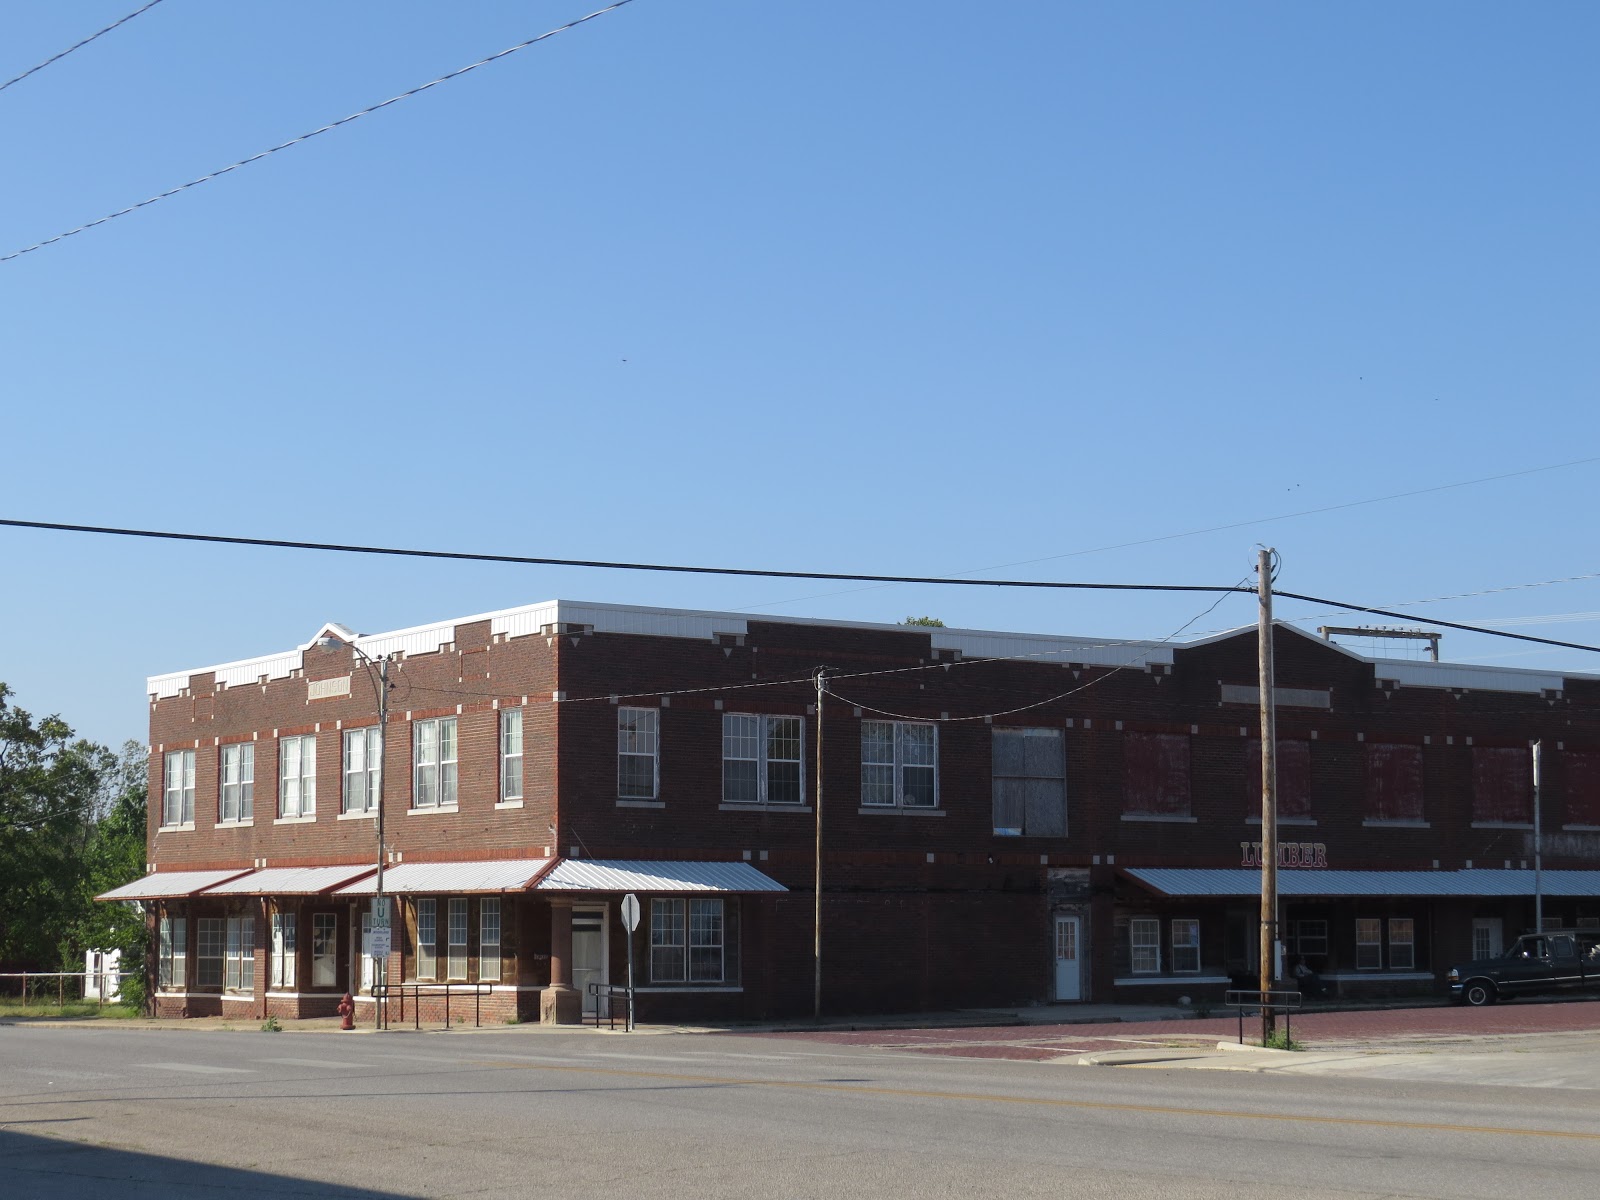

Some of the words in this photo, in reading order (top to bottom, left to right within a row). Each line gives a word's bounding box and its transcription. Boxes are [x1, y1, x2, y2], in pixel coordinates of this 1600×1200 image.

[310, 678, 349, 696] JOHNSON
[376, 899, 386, 907] NO
[377, 907, 385, 918] U
[373, 918, 389, 926] TURN
